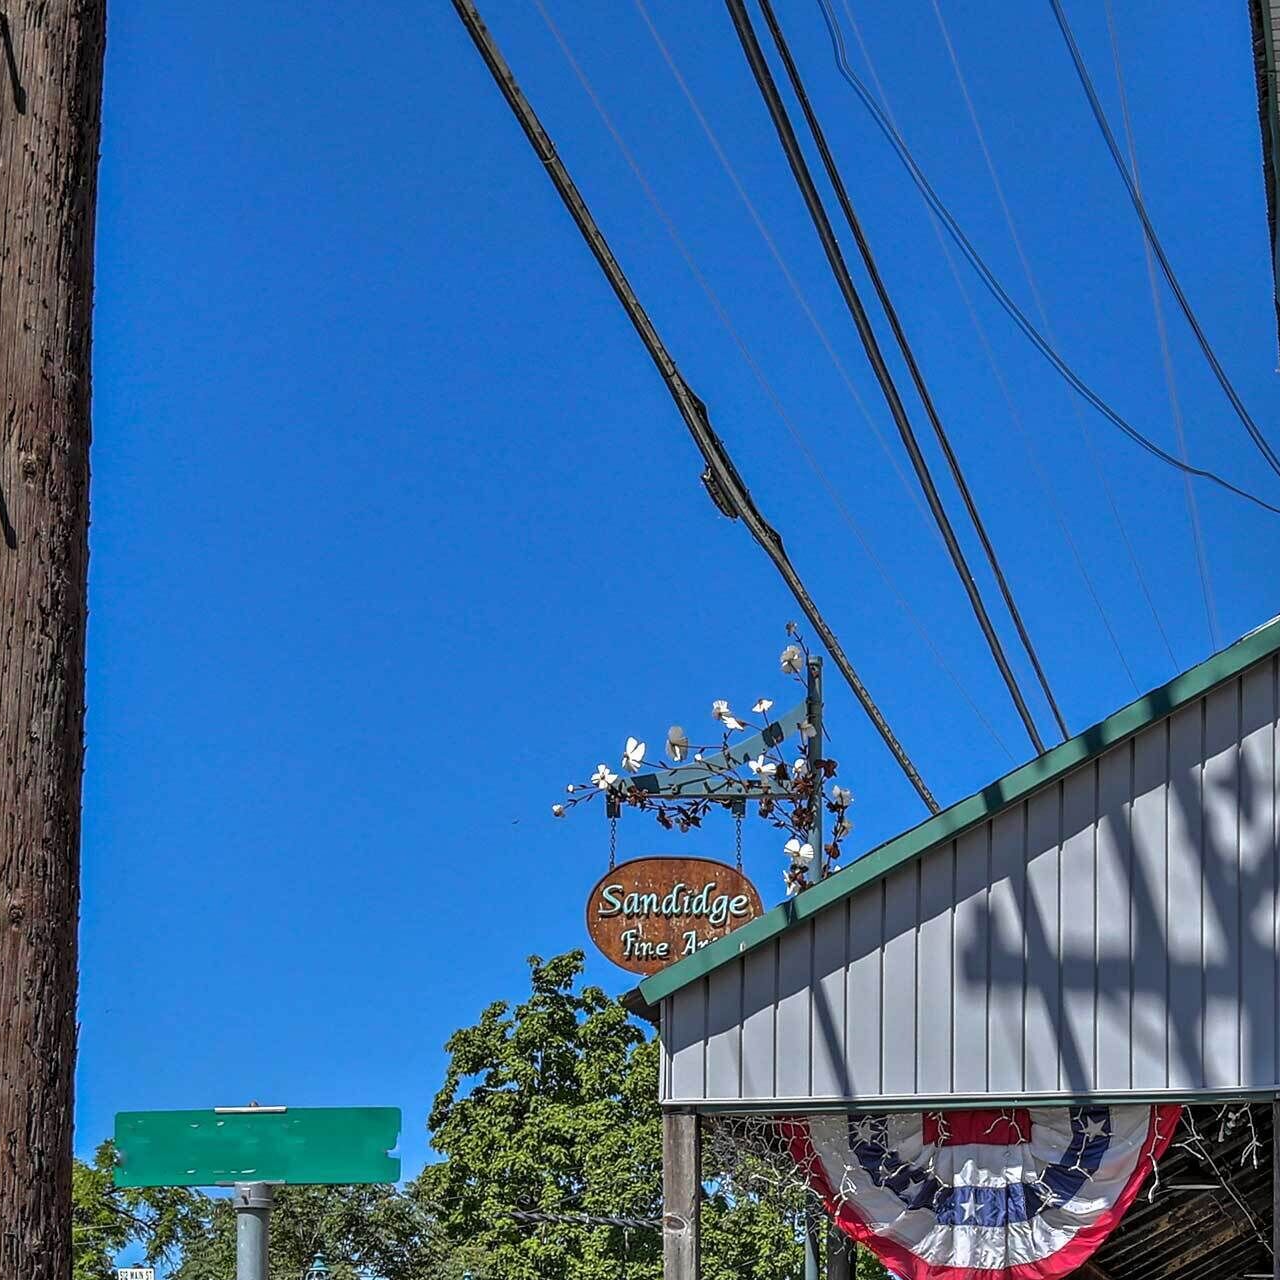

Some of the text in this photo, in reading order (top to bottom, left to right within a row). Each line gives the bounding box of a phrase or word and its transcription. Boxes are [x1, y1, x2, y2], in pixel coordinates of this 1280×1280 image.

[598, 881, 748, 926] Sandidge
[621, 928, 669, 956] Fine
[130, 1270, 144, 1280] MAIN
[145, 1270, 152, 1280] ST
